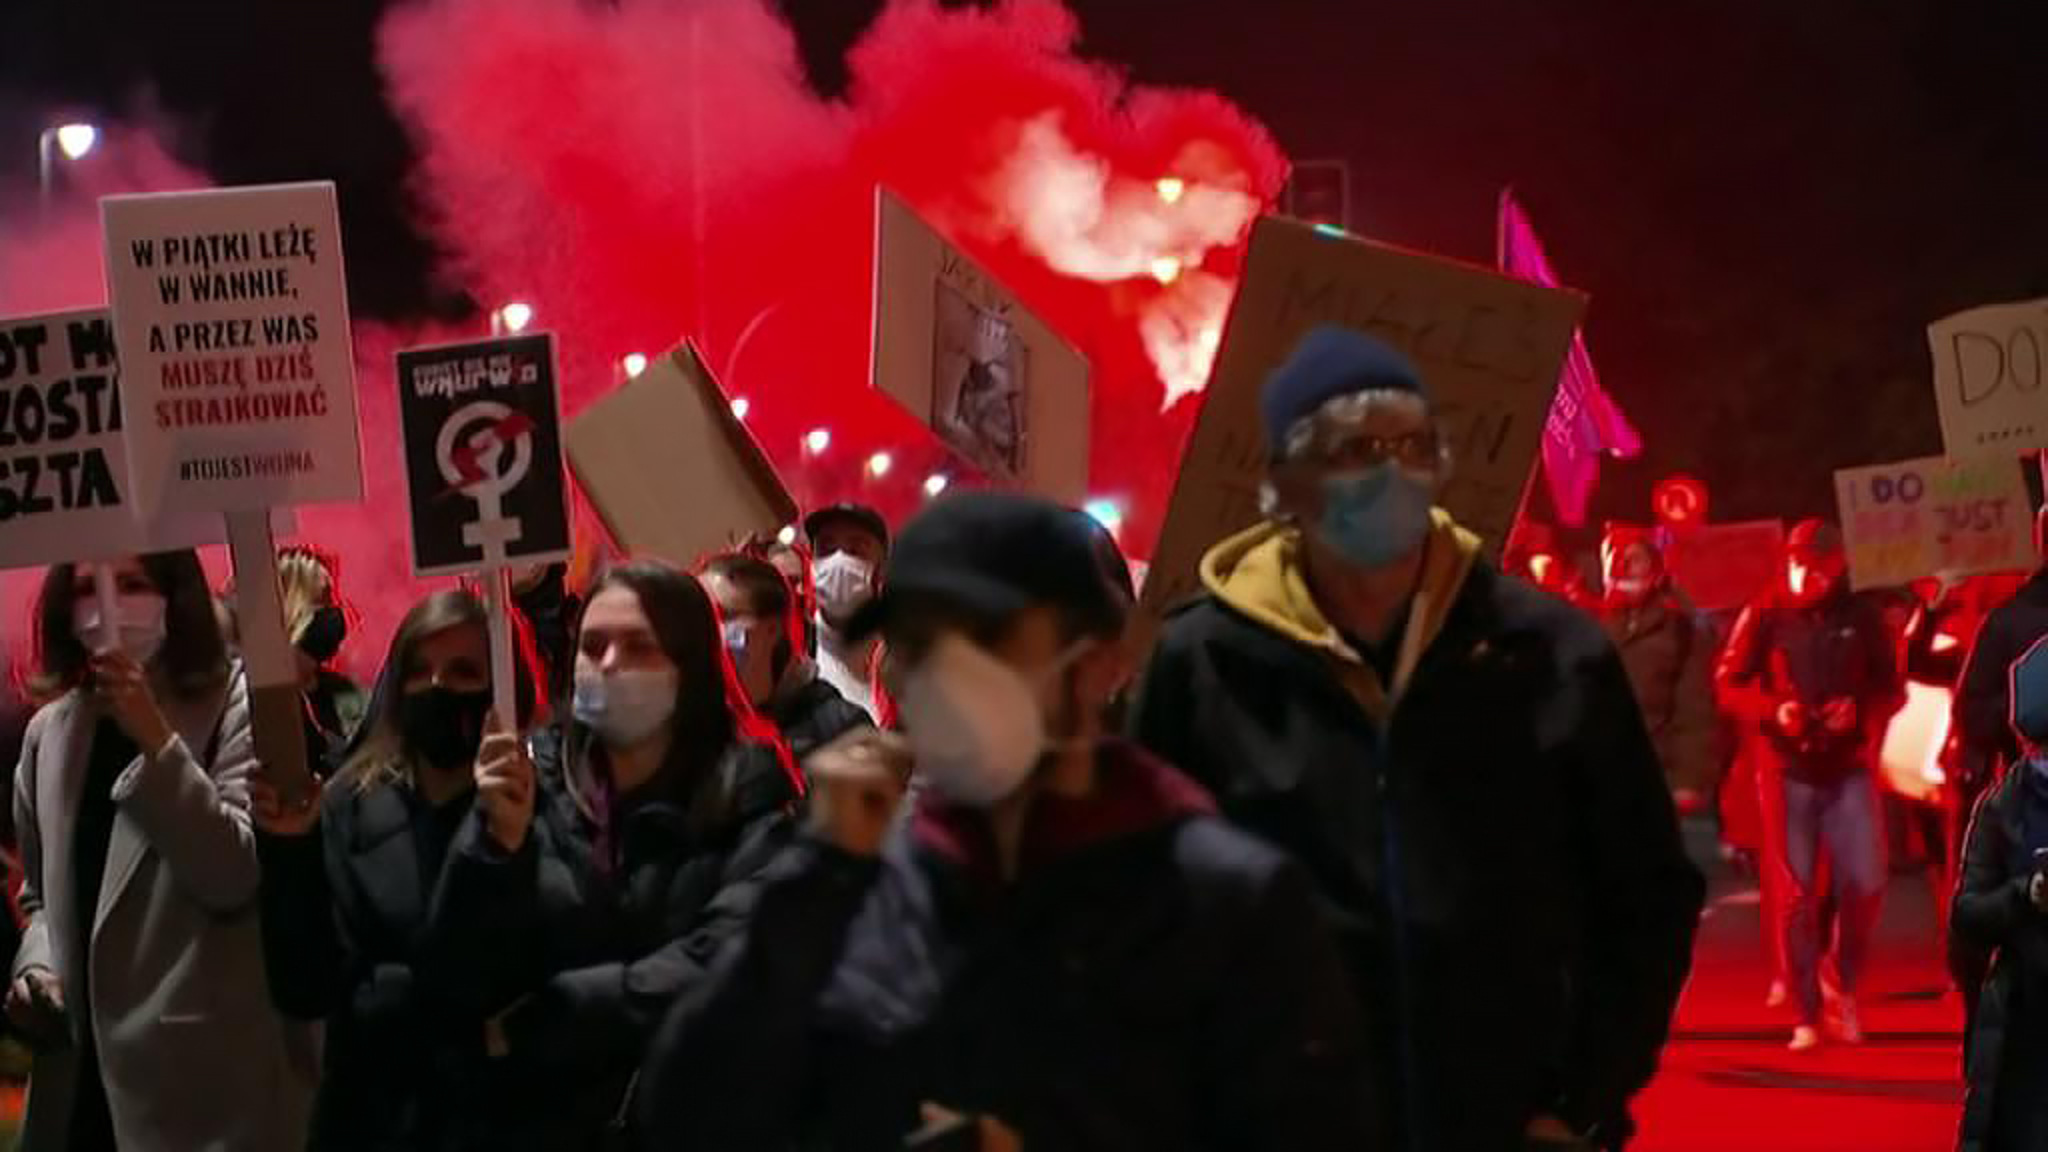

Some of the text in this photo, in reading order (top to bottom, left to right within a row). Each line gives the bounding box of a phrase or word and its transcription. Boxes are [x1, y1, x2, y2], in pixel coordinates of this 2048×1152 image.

[131, 221, 317, 270] W PIĄTKI LEŻĘ
[159, 268, 298, 304] W WANNIE,
[149, 313, 319, 352] A PRZEZ WAS
[161, 344, 315, 390] MUSZĘ DZIŚ
[156, 383, 328, 431] STRAJKOWAĆ
